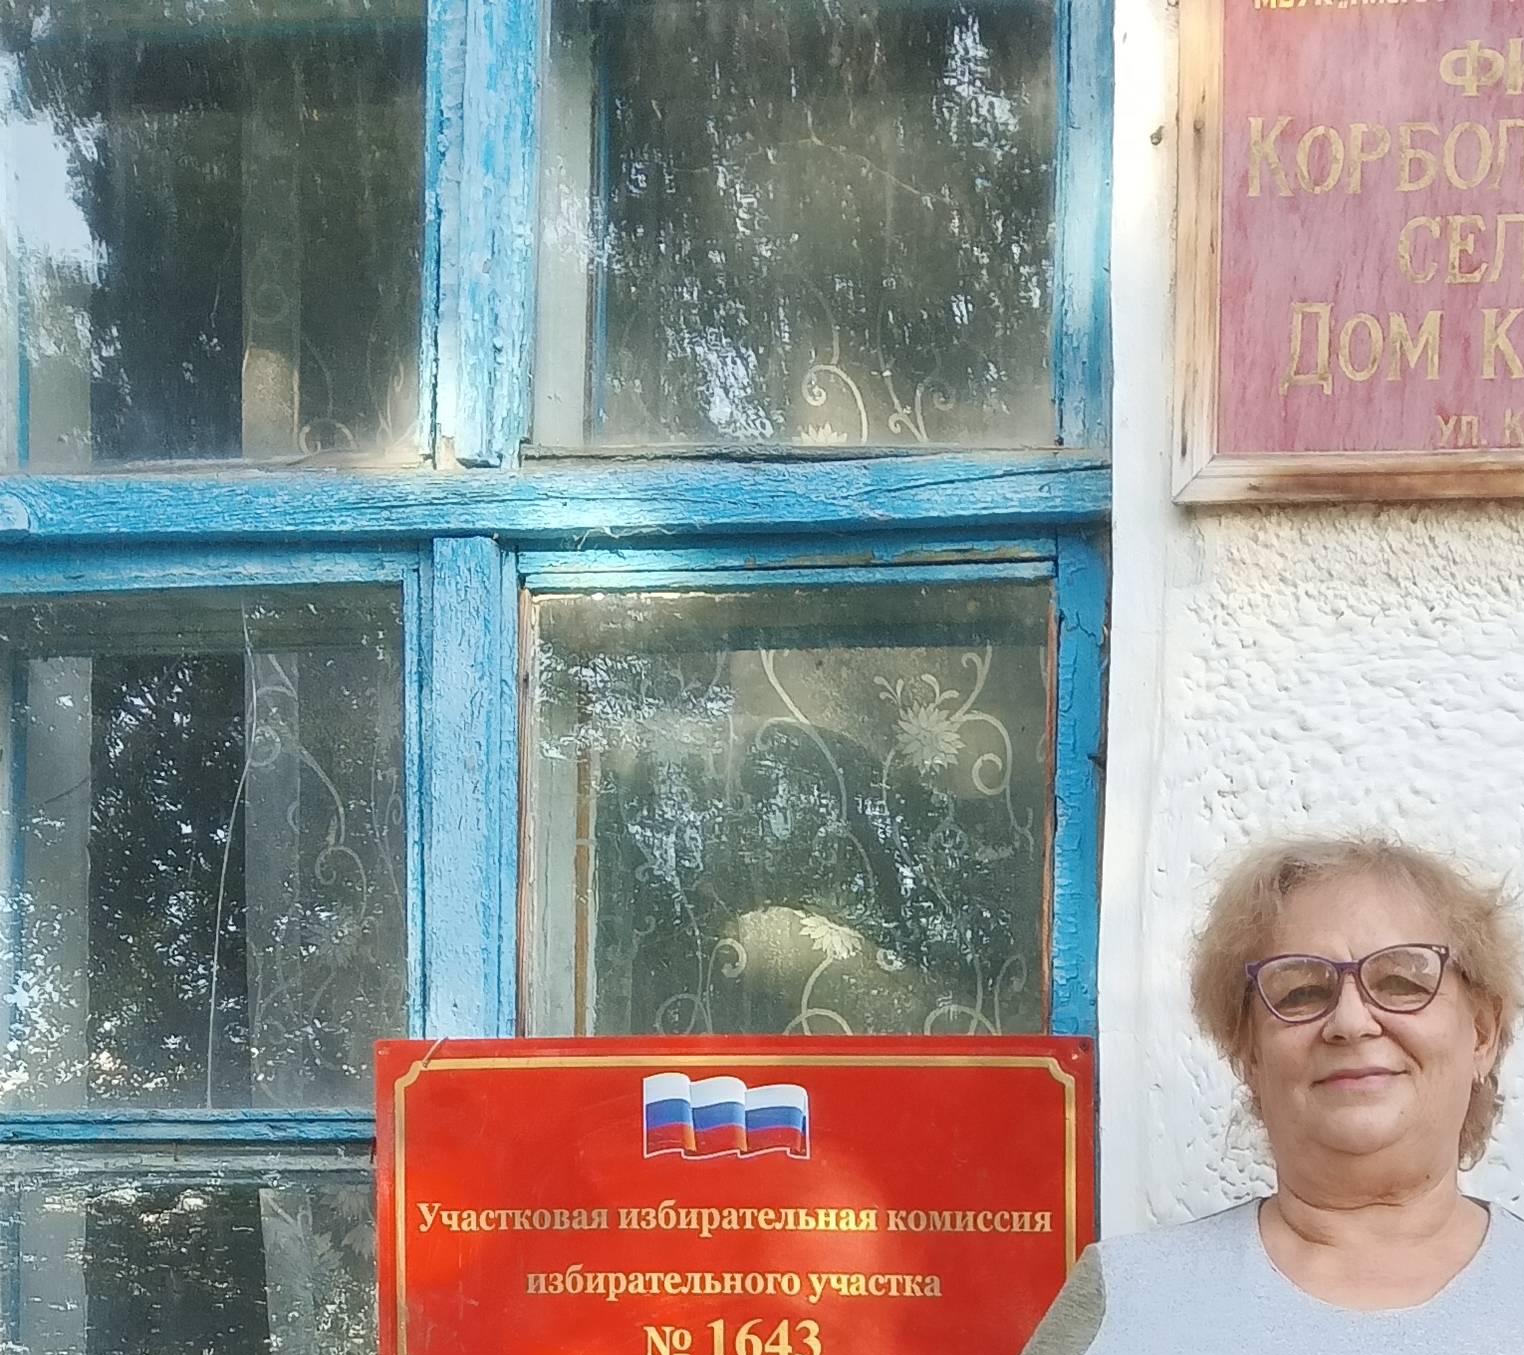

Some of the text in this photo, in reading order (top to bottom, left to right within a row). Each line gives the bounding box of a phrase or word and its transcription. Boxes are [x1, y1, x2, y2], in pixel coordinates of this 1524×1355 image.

[1278, 301, 1445, 397] ДОМ
[416, 1199, 1053, 1239] Участковая избирательная комиссия
[526, 1262, 943, 1304] избирательного участка
